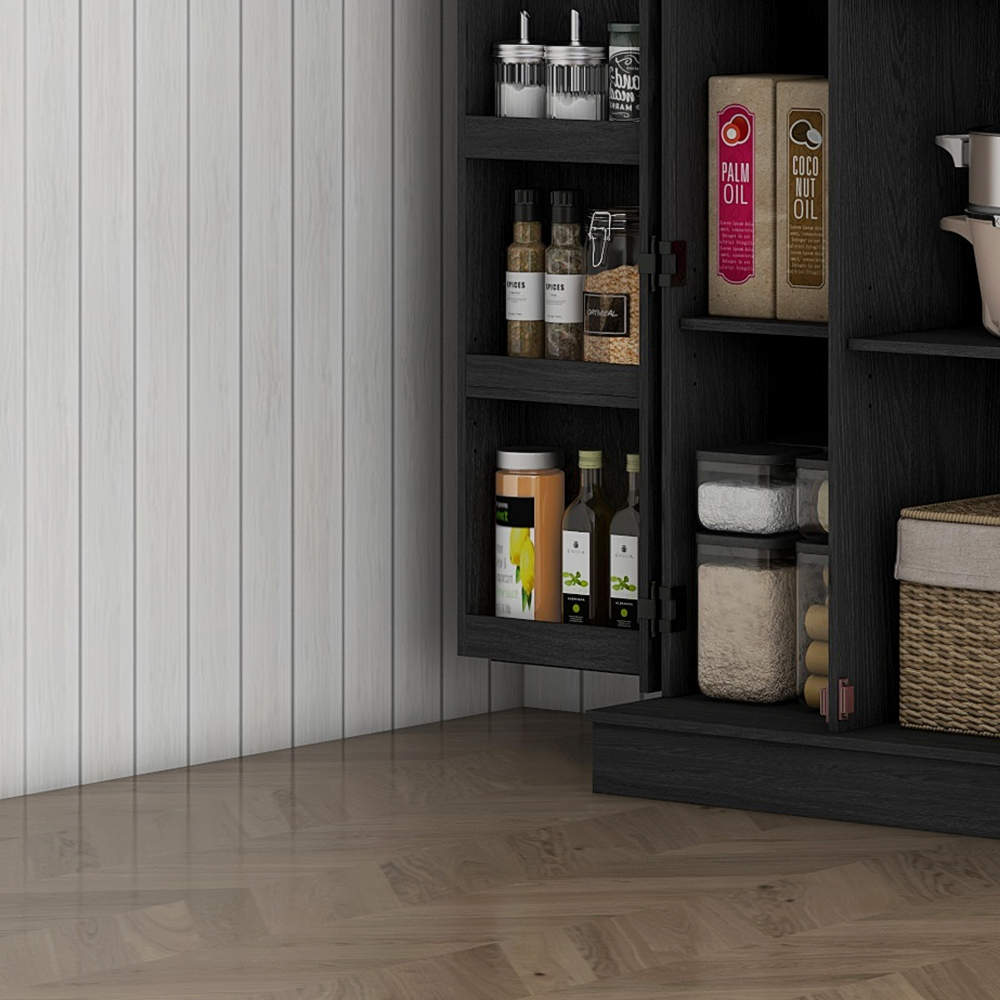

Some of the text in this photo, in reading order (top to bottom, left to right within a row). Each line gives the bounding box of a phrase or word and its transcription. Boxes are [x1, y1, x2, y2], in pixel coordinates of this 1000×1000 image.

[722, 162, 750, 183] PALM
[792, 155, 819, 177] COCO
[723, 183, 749, 205] OIL
[795, 177, 816, 198] NUT
[793, 198, 818, 220] OIL
[506, 281, 526, 289] SPICES
[545, 283, 565, 291] SPICES
